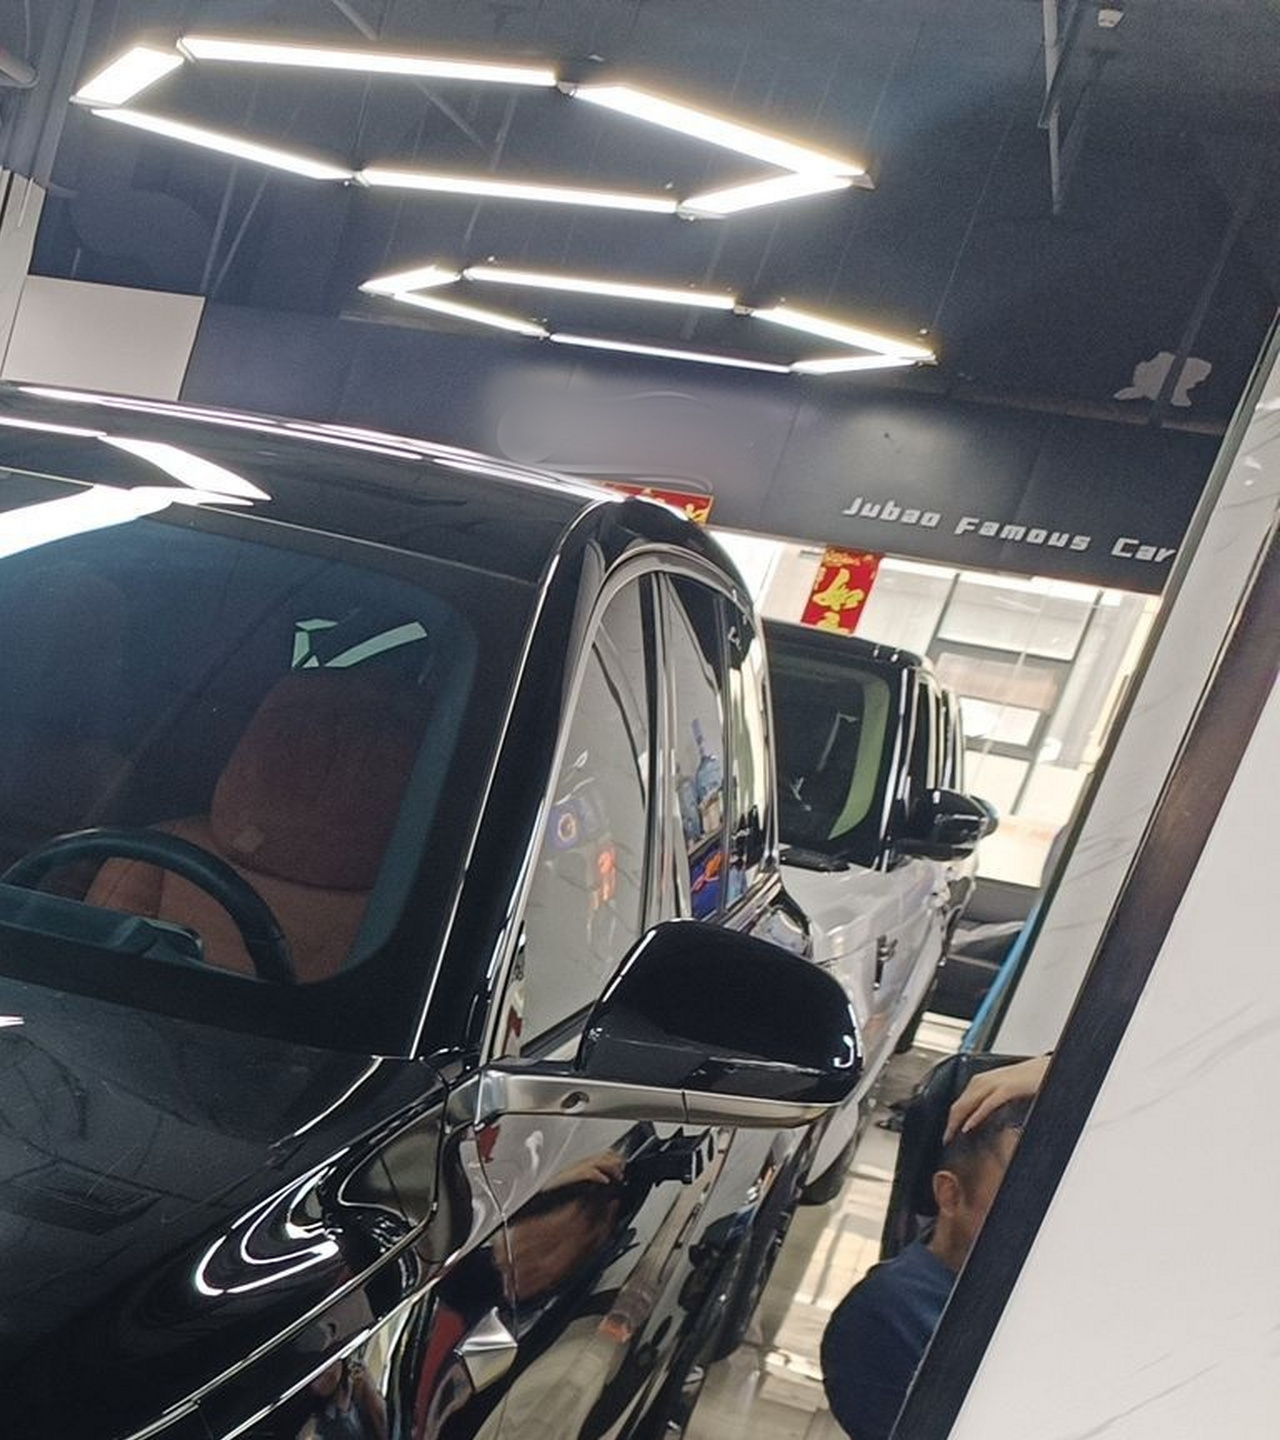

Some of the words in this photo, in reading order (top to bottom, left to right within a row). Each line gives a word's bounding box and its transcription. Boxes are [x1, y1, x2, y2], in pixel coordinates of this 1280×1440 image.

[843, 497, 941, 528] Jubao
[955, 516, 1092, 551] Famous
[1111, 536, 1177, 563] Car
